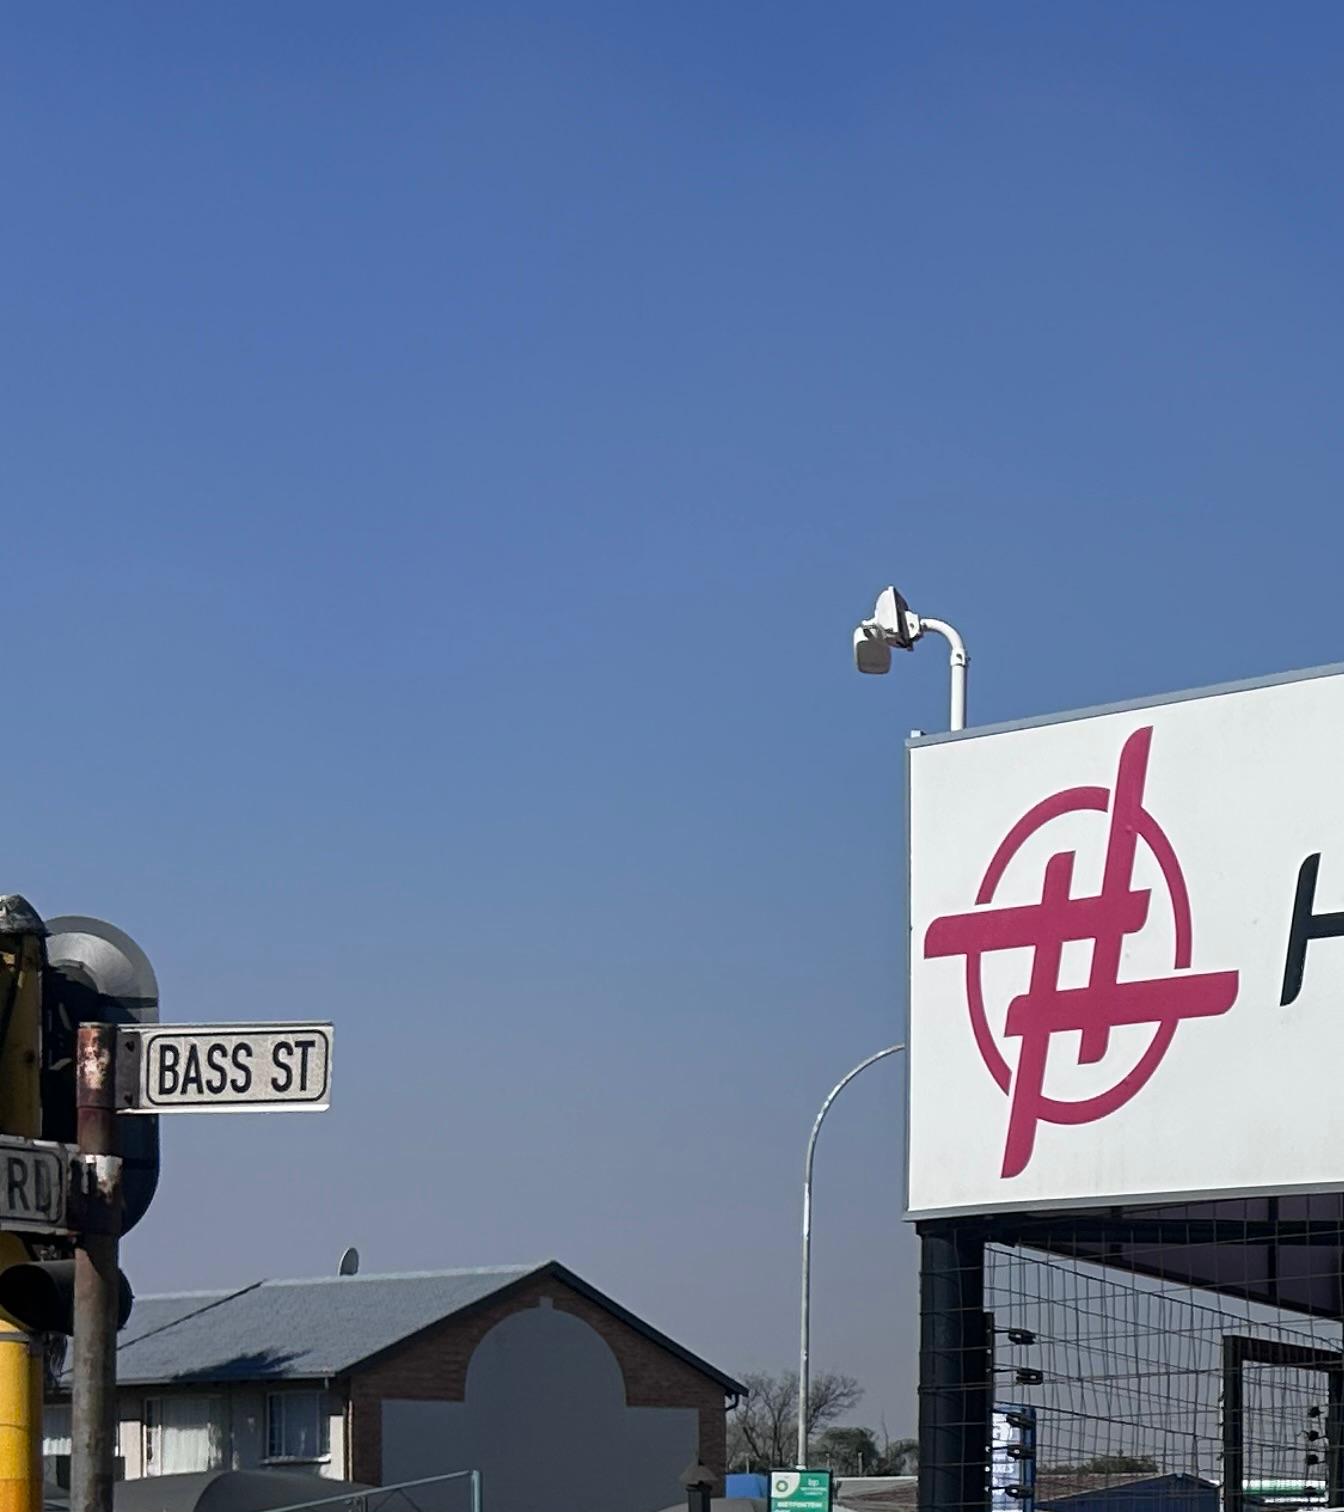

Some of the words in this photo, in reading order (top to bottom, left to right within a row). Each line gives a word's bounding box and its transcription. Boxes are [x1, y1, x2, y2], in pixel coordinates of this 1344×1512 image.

[158, 1043, 253, 1096] BASS
[270, 1040, 316, 1092] ST
[7, 1156, 52, 1213] RD
